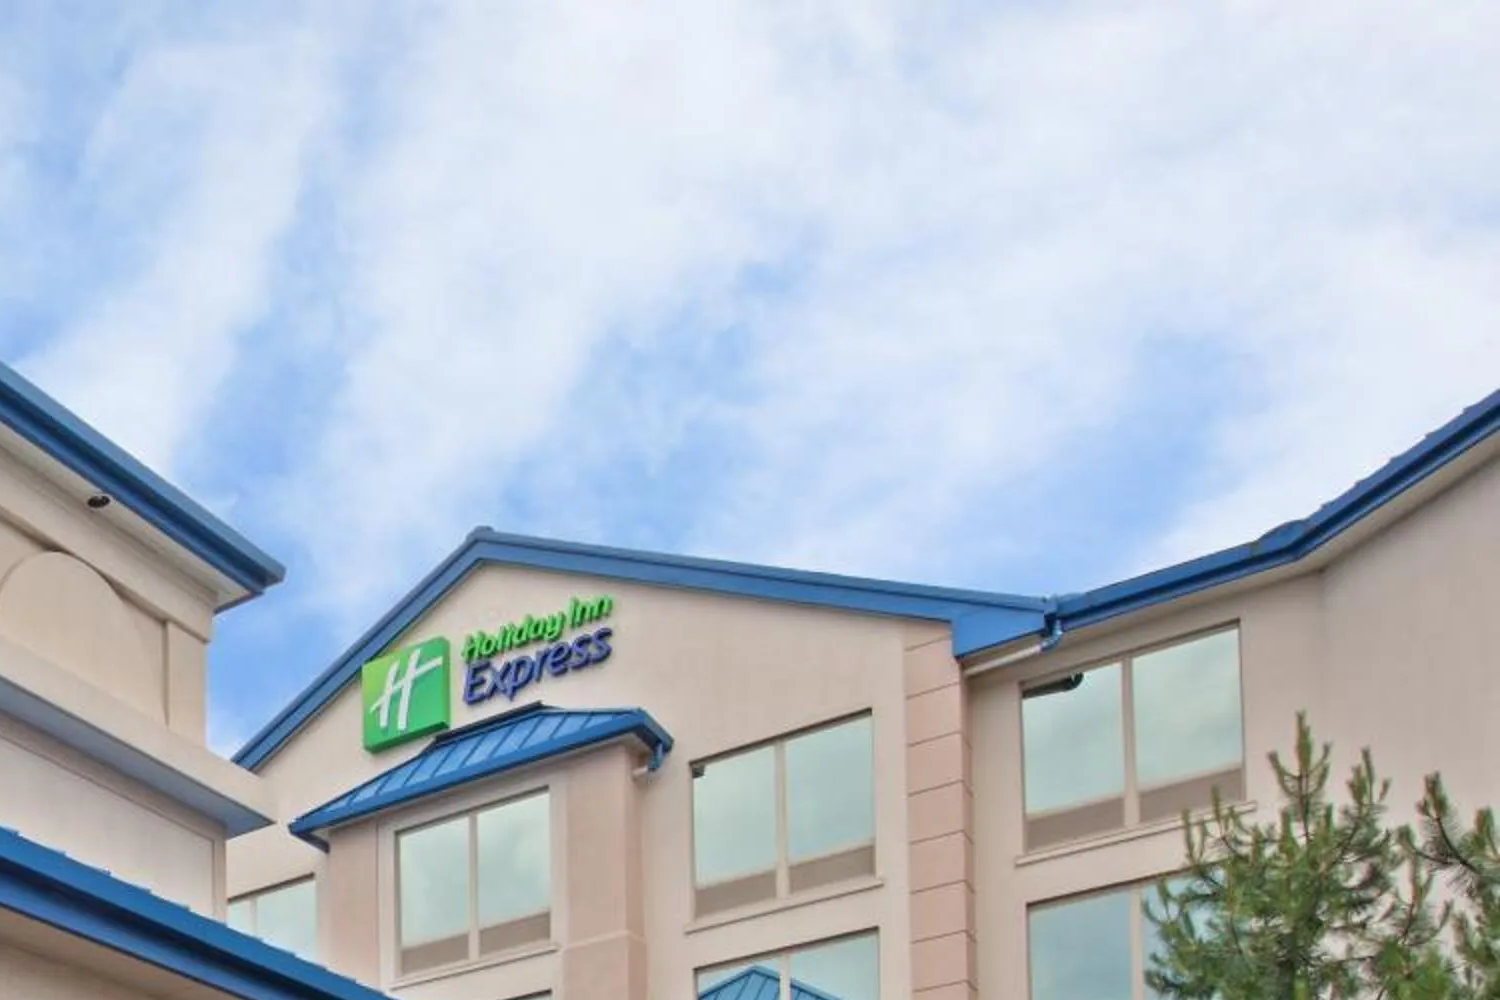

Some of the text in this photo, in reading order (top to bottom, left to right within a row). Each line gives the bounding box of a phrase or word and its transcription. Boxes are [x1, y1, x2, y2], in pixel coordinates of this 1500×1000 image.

[462, 596, 613, 661] Holiday Inn
[463, 627, 613, 705] Express
